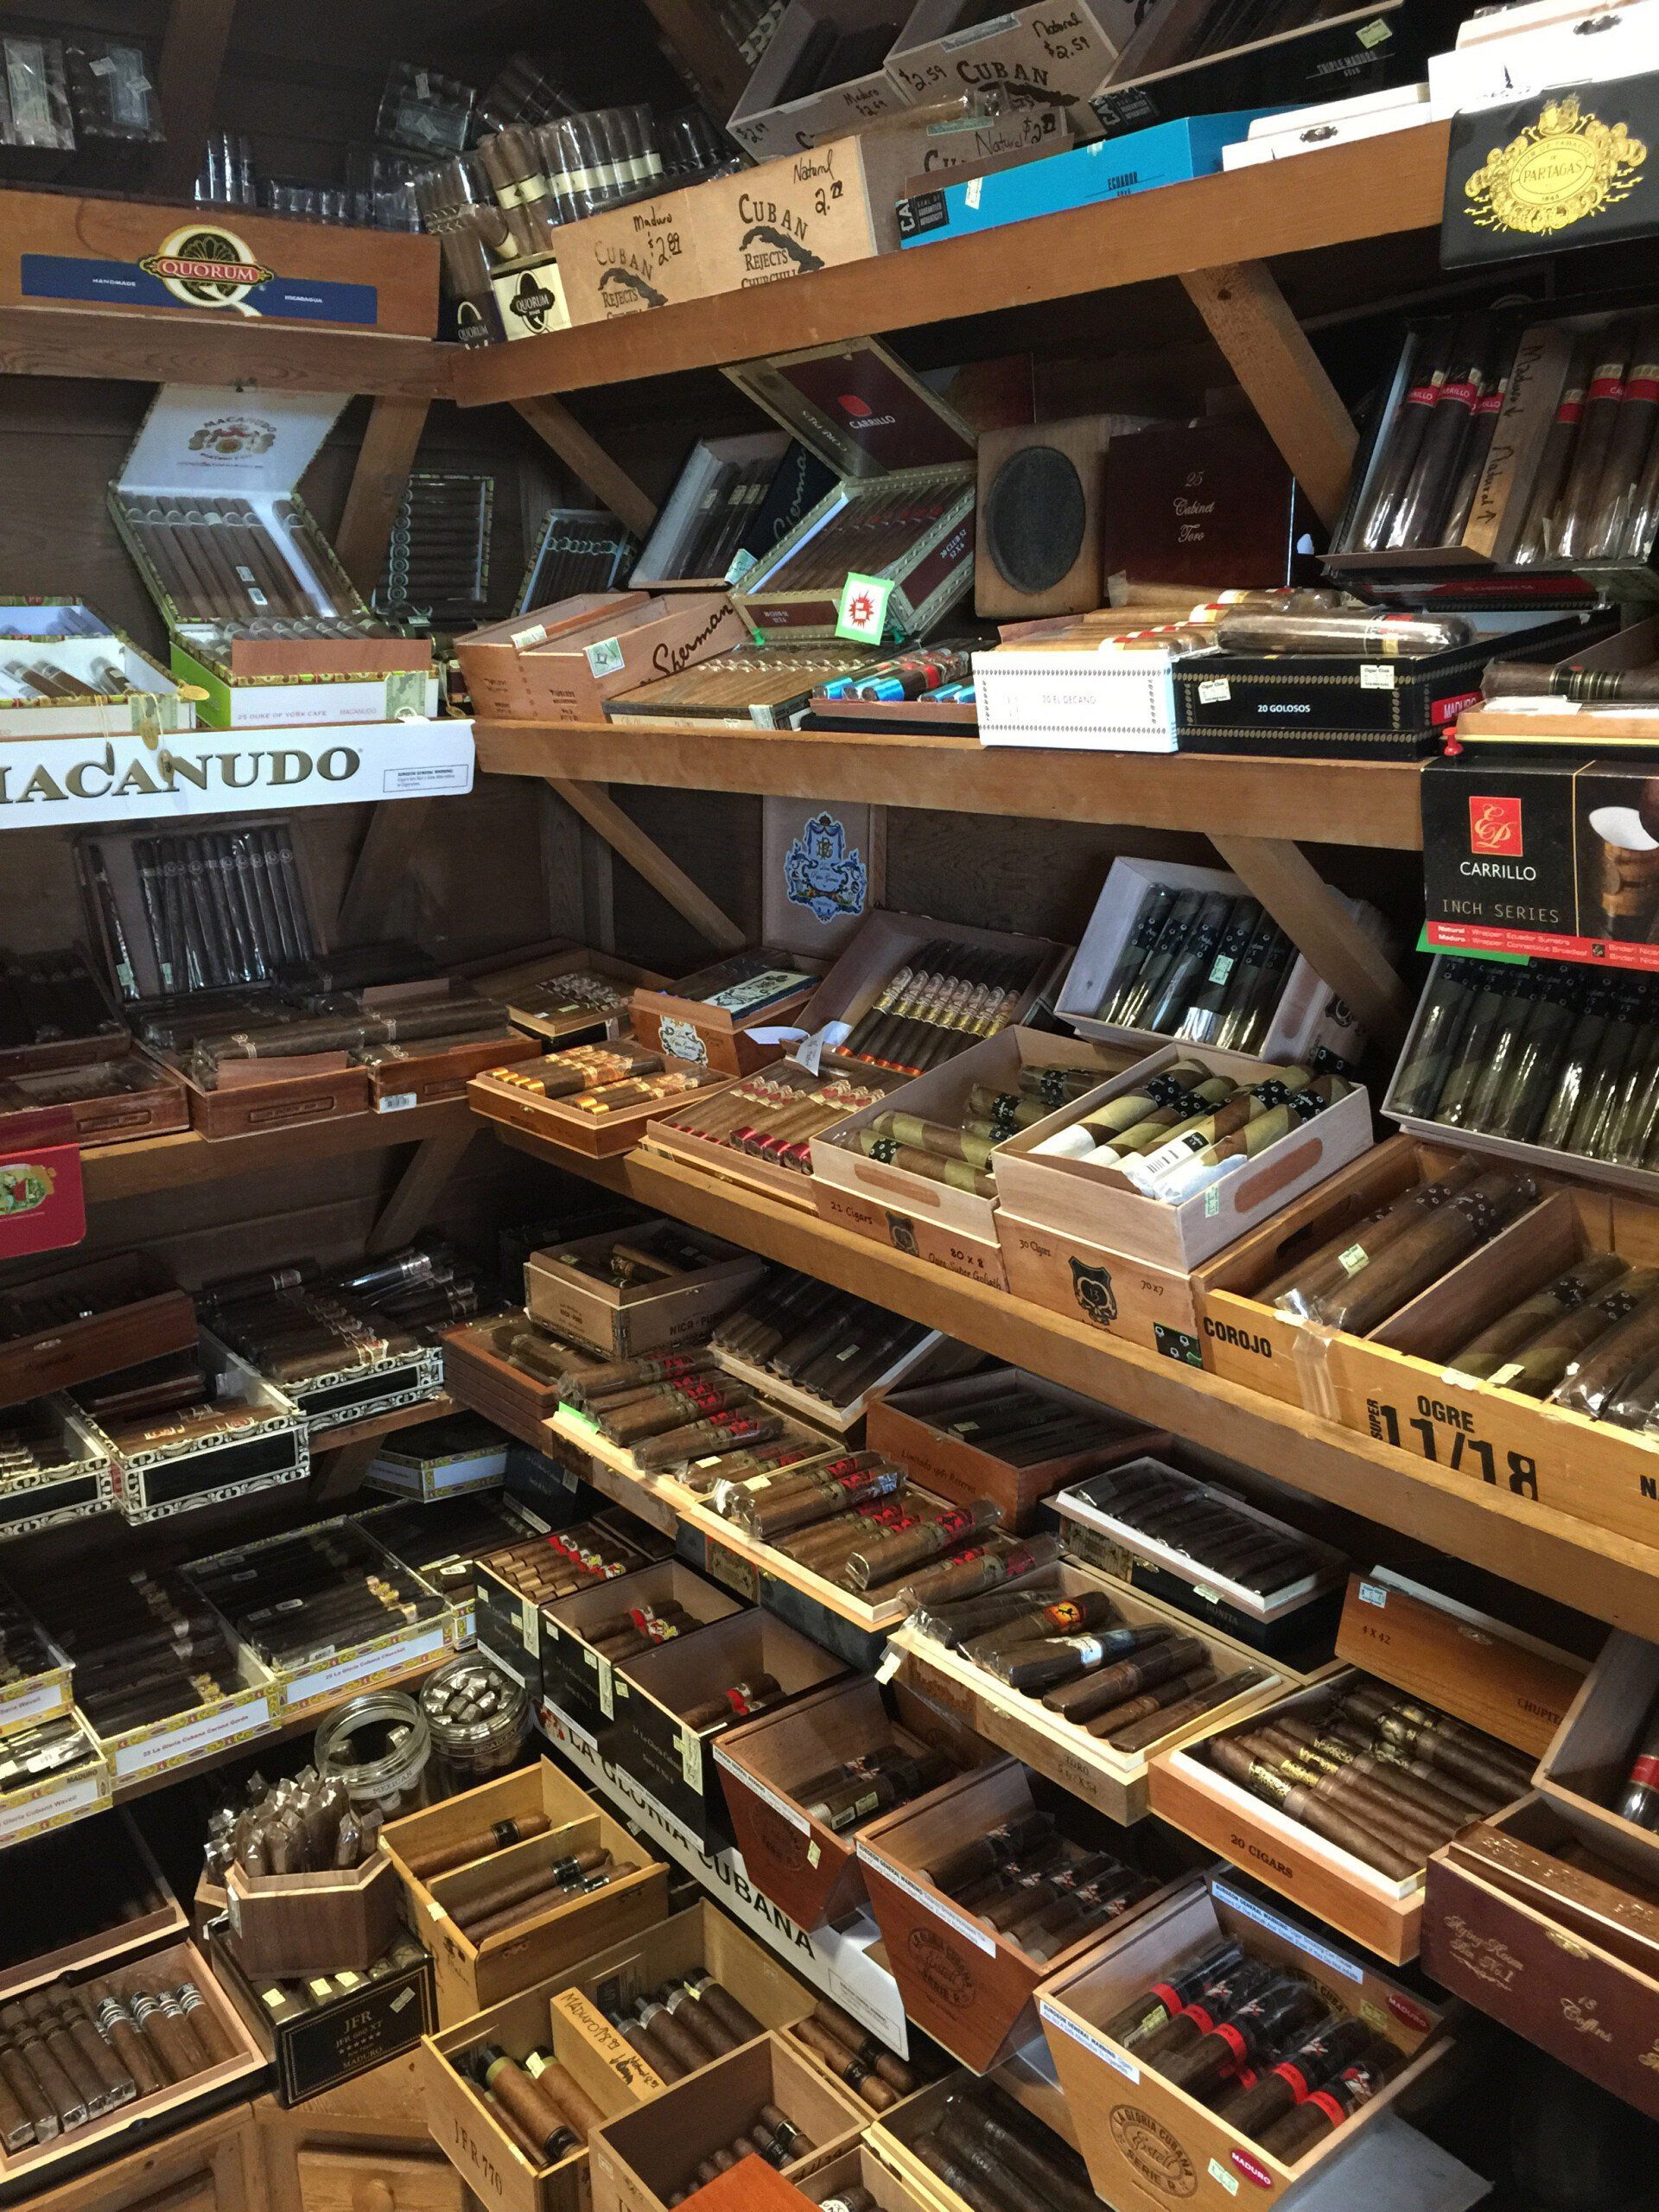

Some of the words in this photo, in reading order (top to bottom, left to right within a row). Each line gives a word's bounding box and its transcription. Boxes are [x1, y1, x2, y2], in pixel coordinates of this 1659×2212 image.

[957, 60, 1048, 86] CUBAN
[975, 130, 1023, 156] Natural
[794, 149, 835, 183] Natural
[1522, 160, 1583, 183] PARTAGAS
[1108, 172, 1138, 190] ECUADOR
[739, 193, 808, 241] CUBAN
[162, 260, 253, 281] QUORUM
[594, 239, 654, 281] CUBAN
[745, 250, 788, 271] REJECTS
[92, 277, 137, 287] HANDMADE
[515, 294, 550, 312] QUORUM
[602, 290, 639, 308] REJECTS
[458, 325, 488, 341] QUORUM
[849, 415, 896, 429] CARRILLO
[1173, 498, 1215, 516] Cabinet
[1178, 524, 1205, 543] Toro
[652, 603, 735, 677] Sherman
[1257, 704, 1268, 713] 20
[1269, 704, 1311, 713] GOLOSOS
[1459, 861, 1536, 881] CARRILLO
[1442, 899, 1483, 915] INCH
[1495, 904, 1559, 924] SERIES
[1438, 925, 1465, 934] Natural
[846, 1206, 873, 1225] Cigars
[1020, 1239, 1029, 1249] 30
[950, 1249, 964, 1261] 80
[973, 1271, 1002, 1290] Goliath
[1203, 1317, 1273, 1359] COROJO
[1417, 1395, 1475, 1433] OGRE
[417, 1619, 442, 1634] MADURO
[1378, 1632, 1392, 1645] 42
[569, 1728, 596, 1765] LA
[67, 1768, 98, 1783] MADURO
[372, 1770, 413, 1795] MEXICAN
[1230, 1834, 1245, 1849] 20
[1248, 1844, 1294, 1879] CIGARS
[1388, 1993, 1427, 2028] MADURO
[346, 2010, 373, 2034] JFR
[1115, 2110, 1126, 2126] LA
[1124, 2108, 1157, 2133] GLORIA
[1159, 2128, 1194, 2177] CUBANA
[453, 2117, 480, 2169] JFR
[481, 2154, 503, 2196] 770
[1126, 2148, 1163, 2187] SERIE
[1231, 2152, 1272, 2186] MADURO
